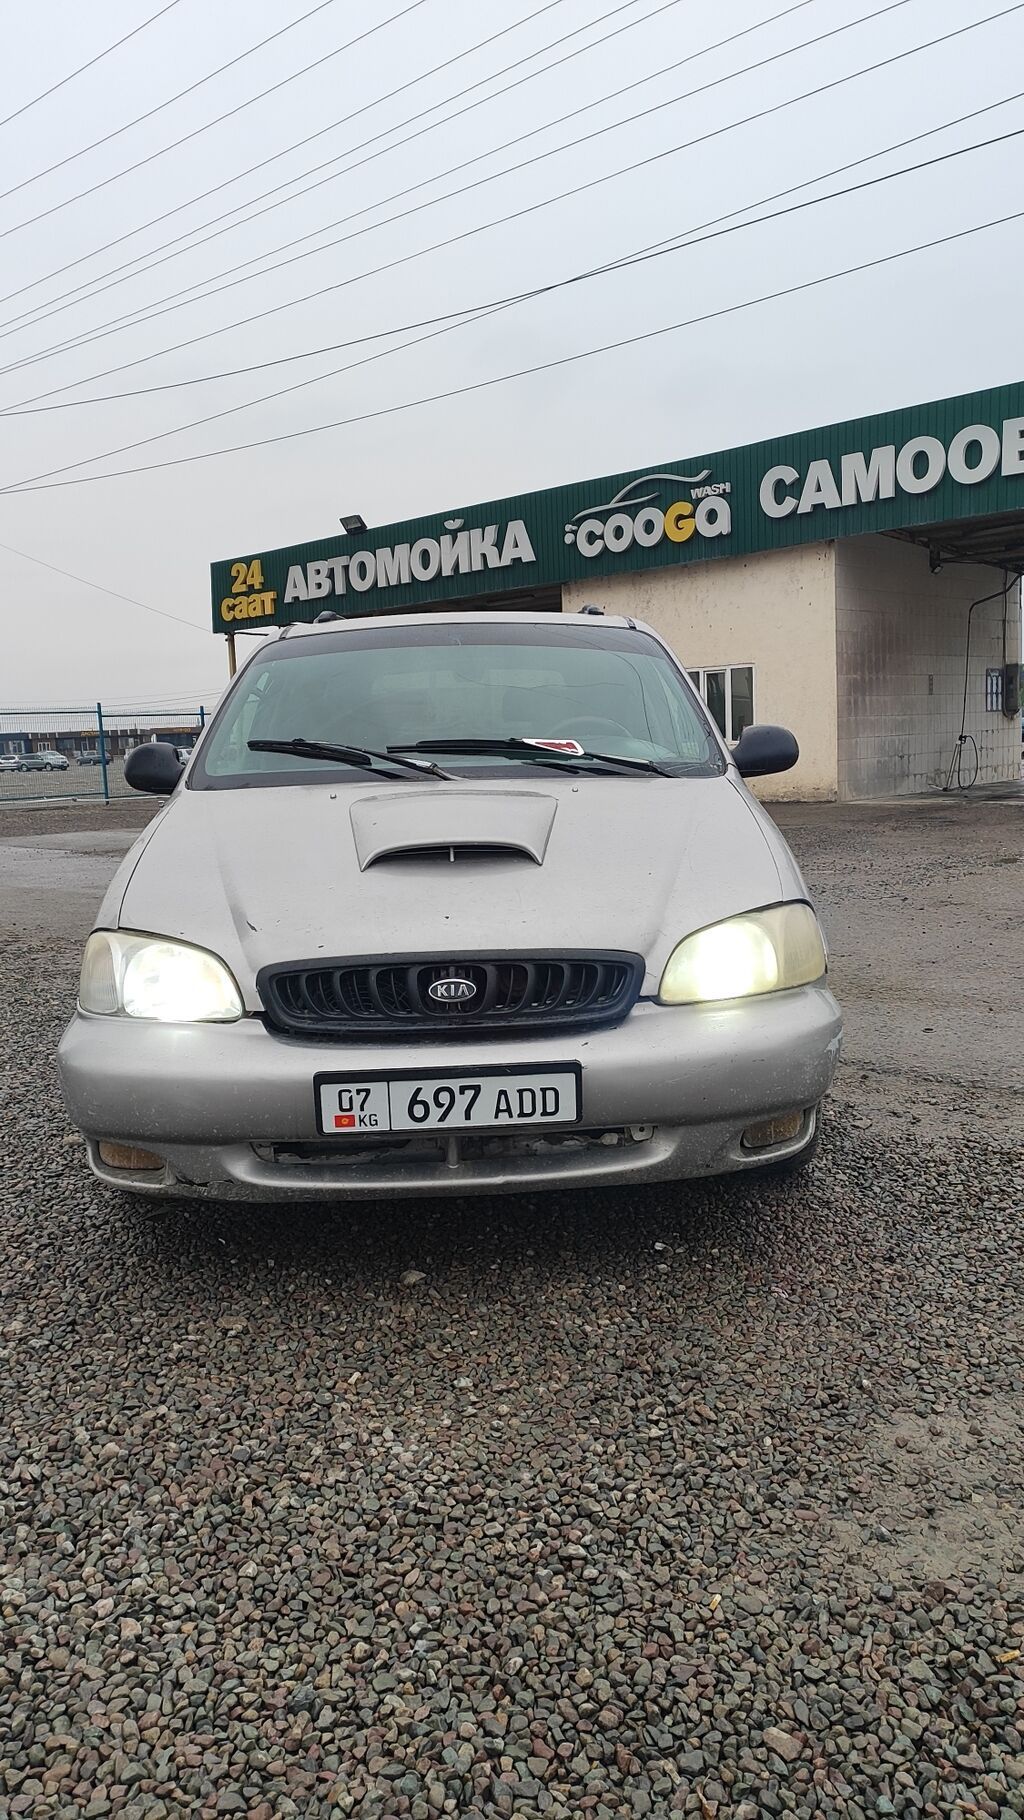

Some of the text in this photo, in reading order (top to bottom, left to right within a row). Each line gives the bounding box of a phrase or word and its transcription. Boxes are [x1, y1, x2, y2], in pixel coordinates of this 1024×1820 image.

[690, 482, 731, 499] WASH
[231, 559, 264, 593] 24
[284, 518, 536, 604] АВТОМОЙКА
[221, 591, 277, 621] саат
[437, 984, 469, 997] KIA
[338, 1084, 560, 1123] 07 697 ADD
[358, 1114, 378, 1127] KG
